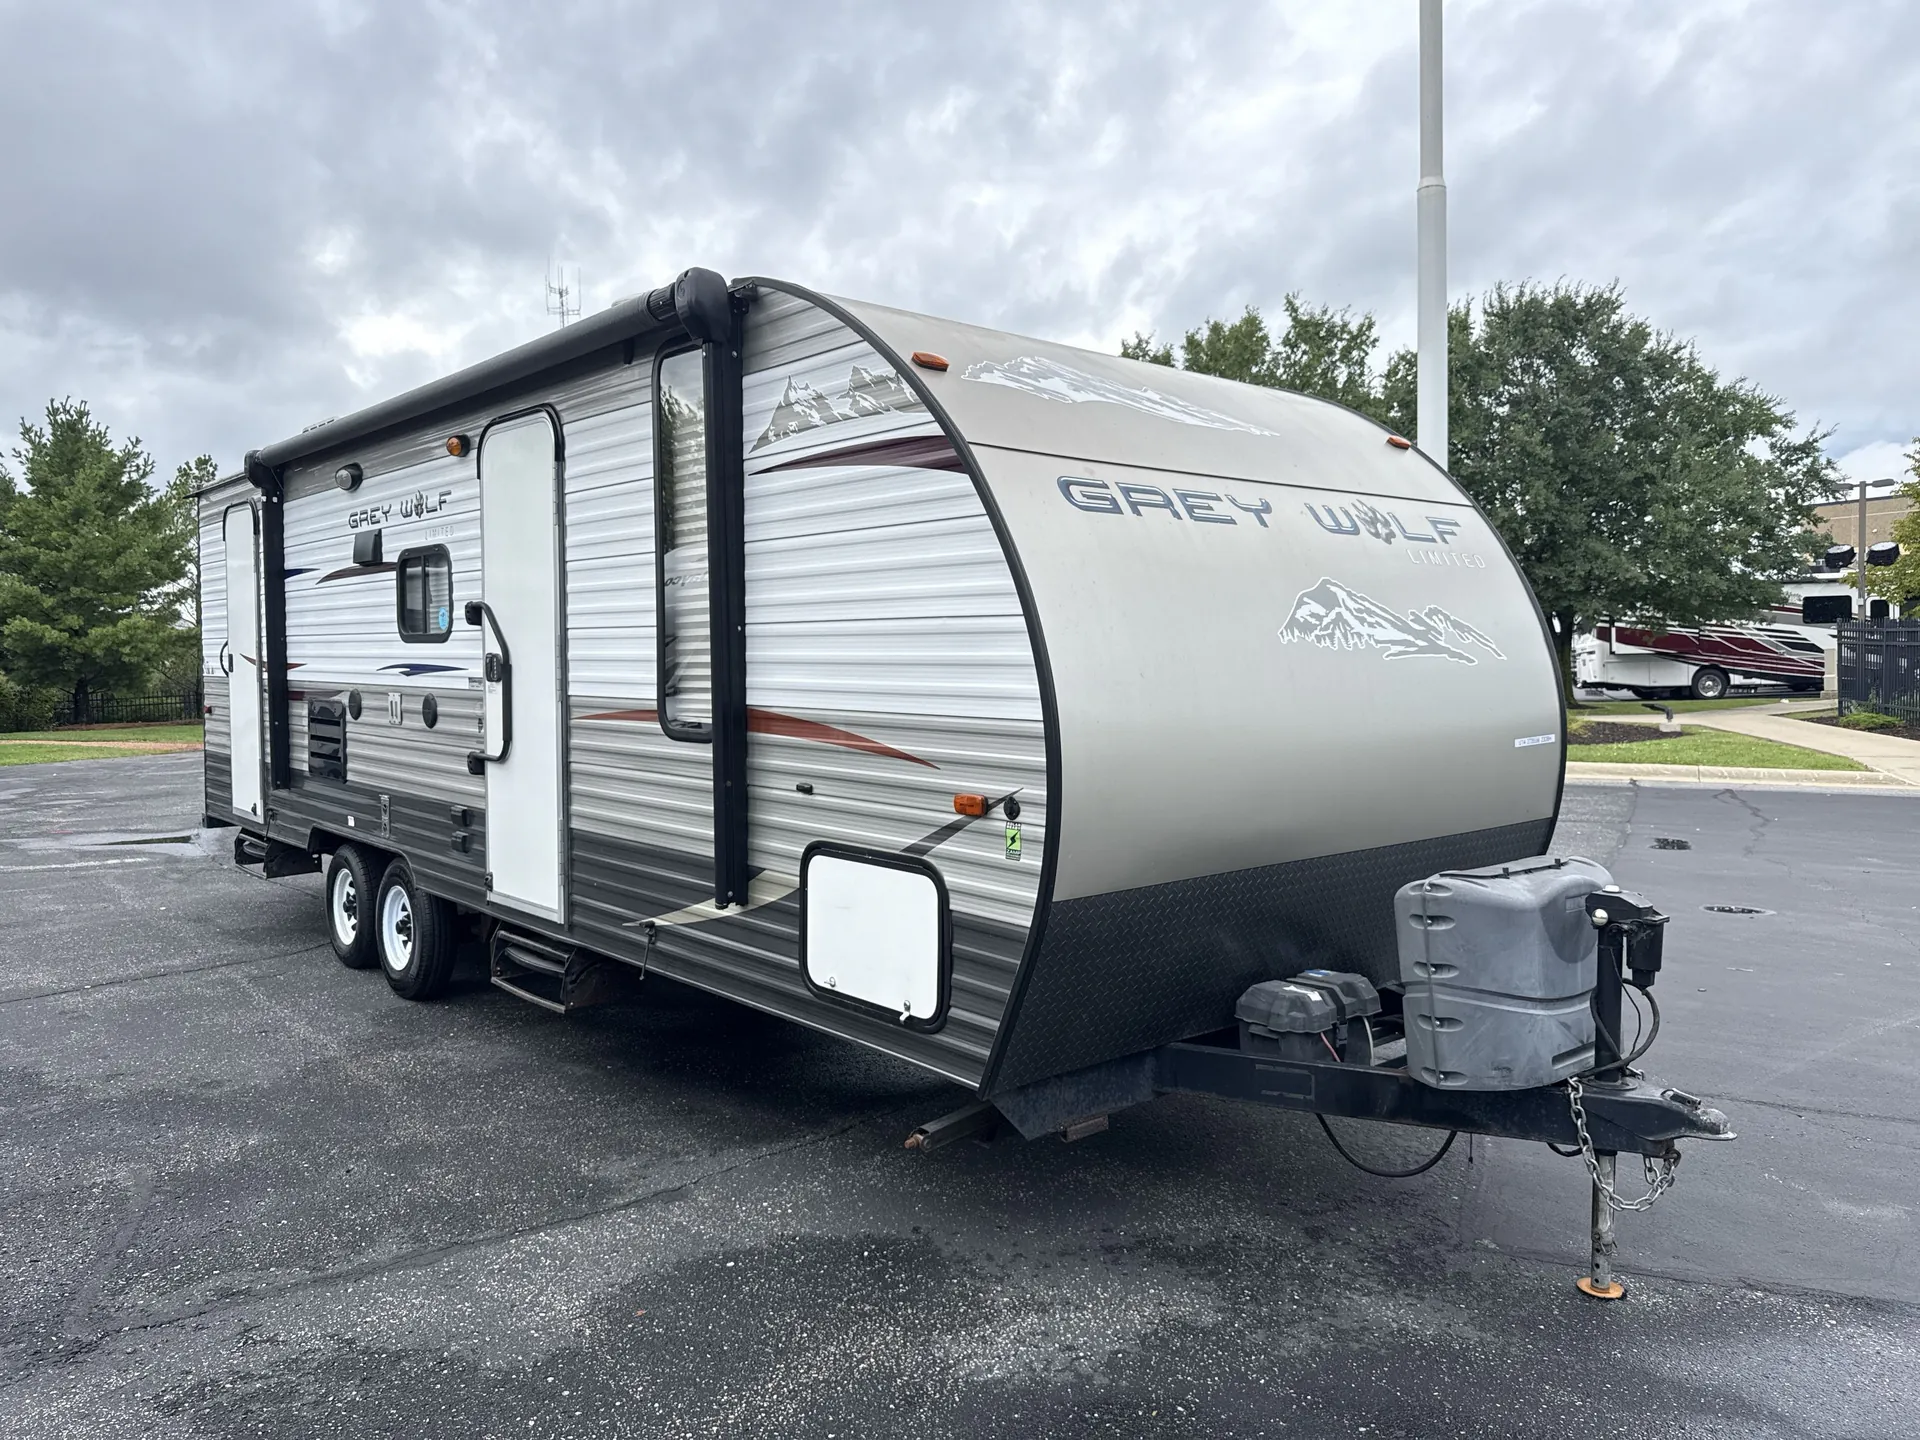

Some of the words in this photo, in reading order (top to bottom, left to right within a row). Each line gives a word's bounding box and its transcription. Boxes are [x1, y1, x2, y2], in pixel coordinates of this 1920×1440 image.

[348, 503, 392, 529] GREY
[400, 489, 452, 518] WOLF
[1056, 475, 1273, 528] GREY
[1304, 498, 1461, 545] WOLF
[424, 525, 455, 540] LIMITED
[1406, 548, 1486, 569] LIMITED
